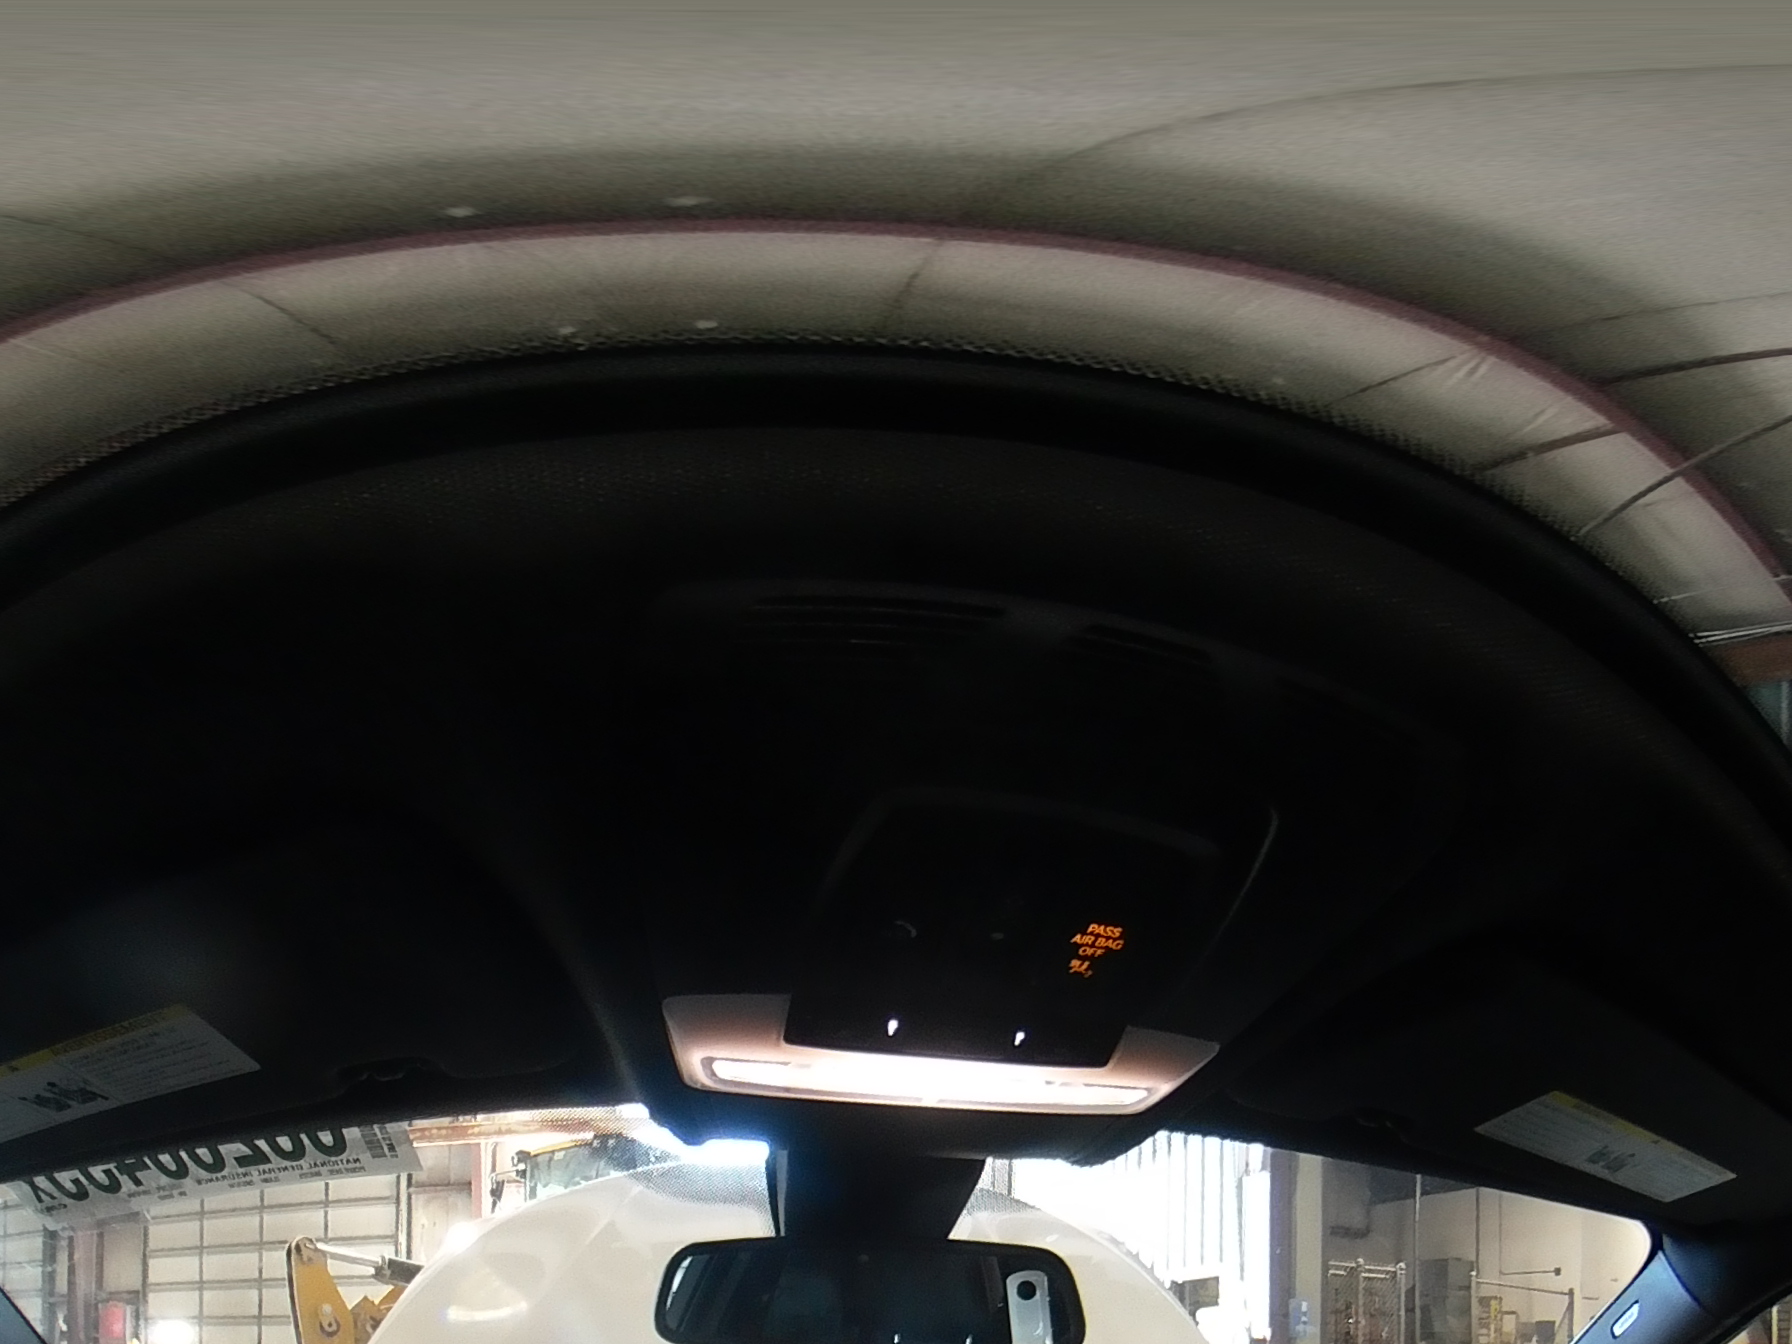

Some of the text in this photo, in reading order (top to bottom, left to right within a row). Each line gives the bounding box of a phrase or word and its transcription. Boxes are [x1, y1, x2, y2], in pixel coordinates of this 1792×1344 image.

[1086, 923, 1124, 938] PASS
[1070, 933, 1125, 950] AIR BAG
[1078, 946, 1105, 958] OFF
